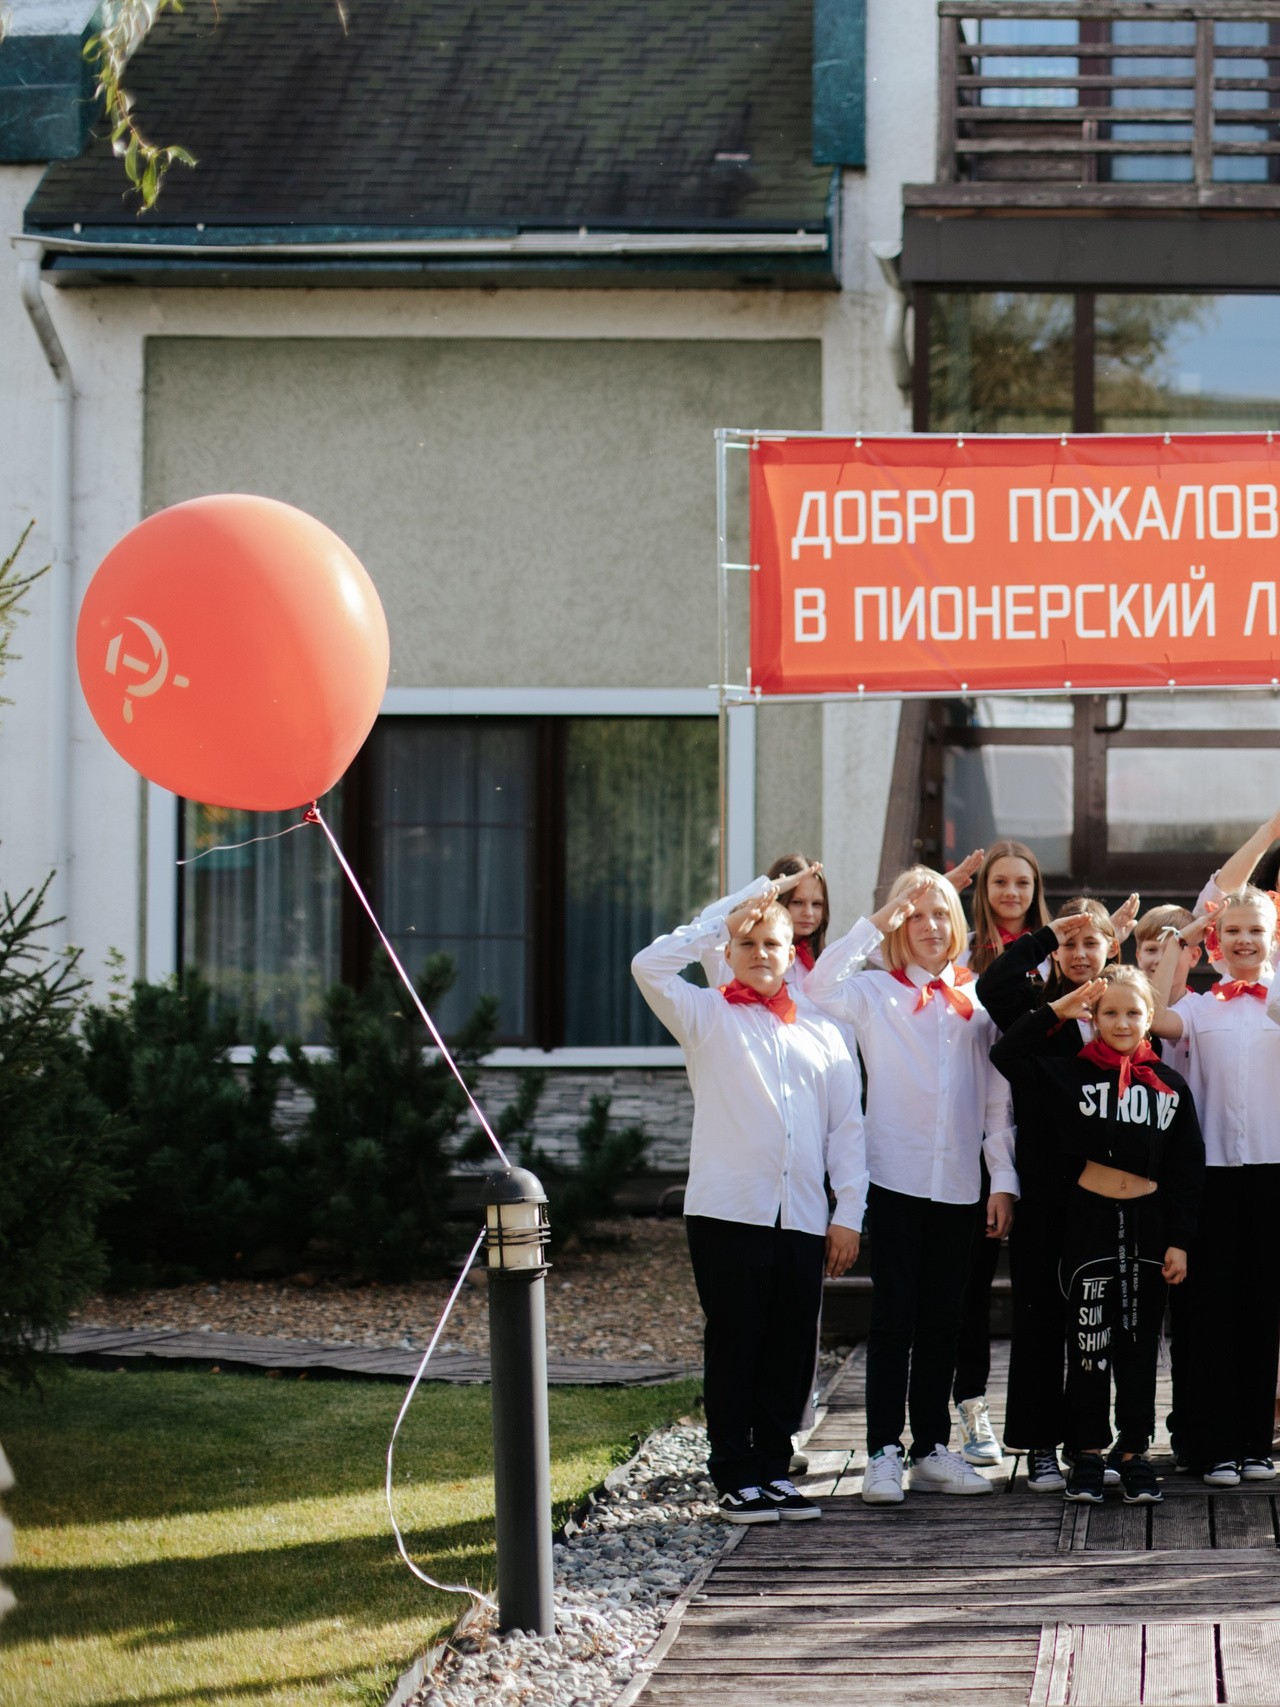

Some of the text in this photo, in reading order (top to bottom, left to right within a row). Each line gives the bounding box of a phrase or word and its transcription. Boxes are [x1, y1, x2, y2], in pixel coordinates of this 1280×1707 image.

[791, 488, 976, 560] ДОБРО
[793, 586, 828, 643] В
[854, 564, 1216, 642] ПИОНЕРСКИЙ
[1079, 1082, 1180, 1131] STRONG
[1082, 1280, 1108, 1300] THE
[1079, 1305, 1103, 1327] SUN
[1078, 1326, 1112, 1352] SHINE
